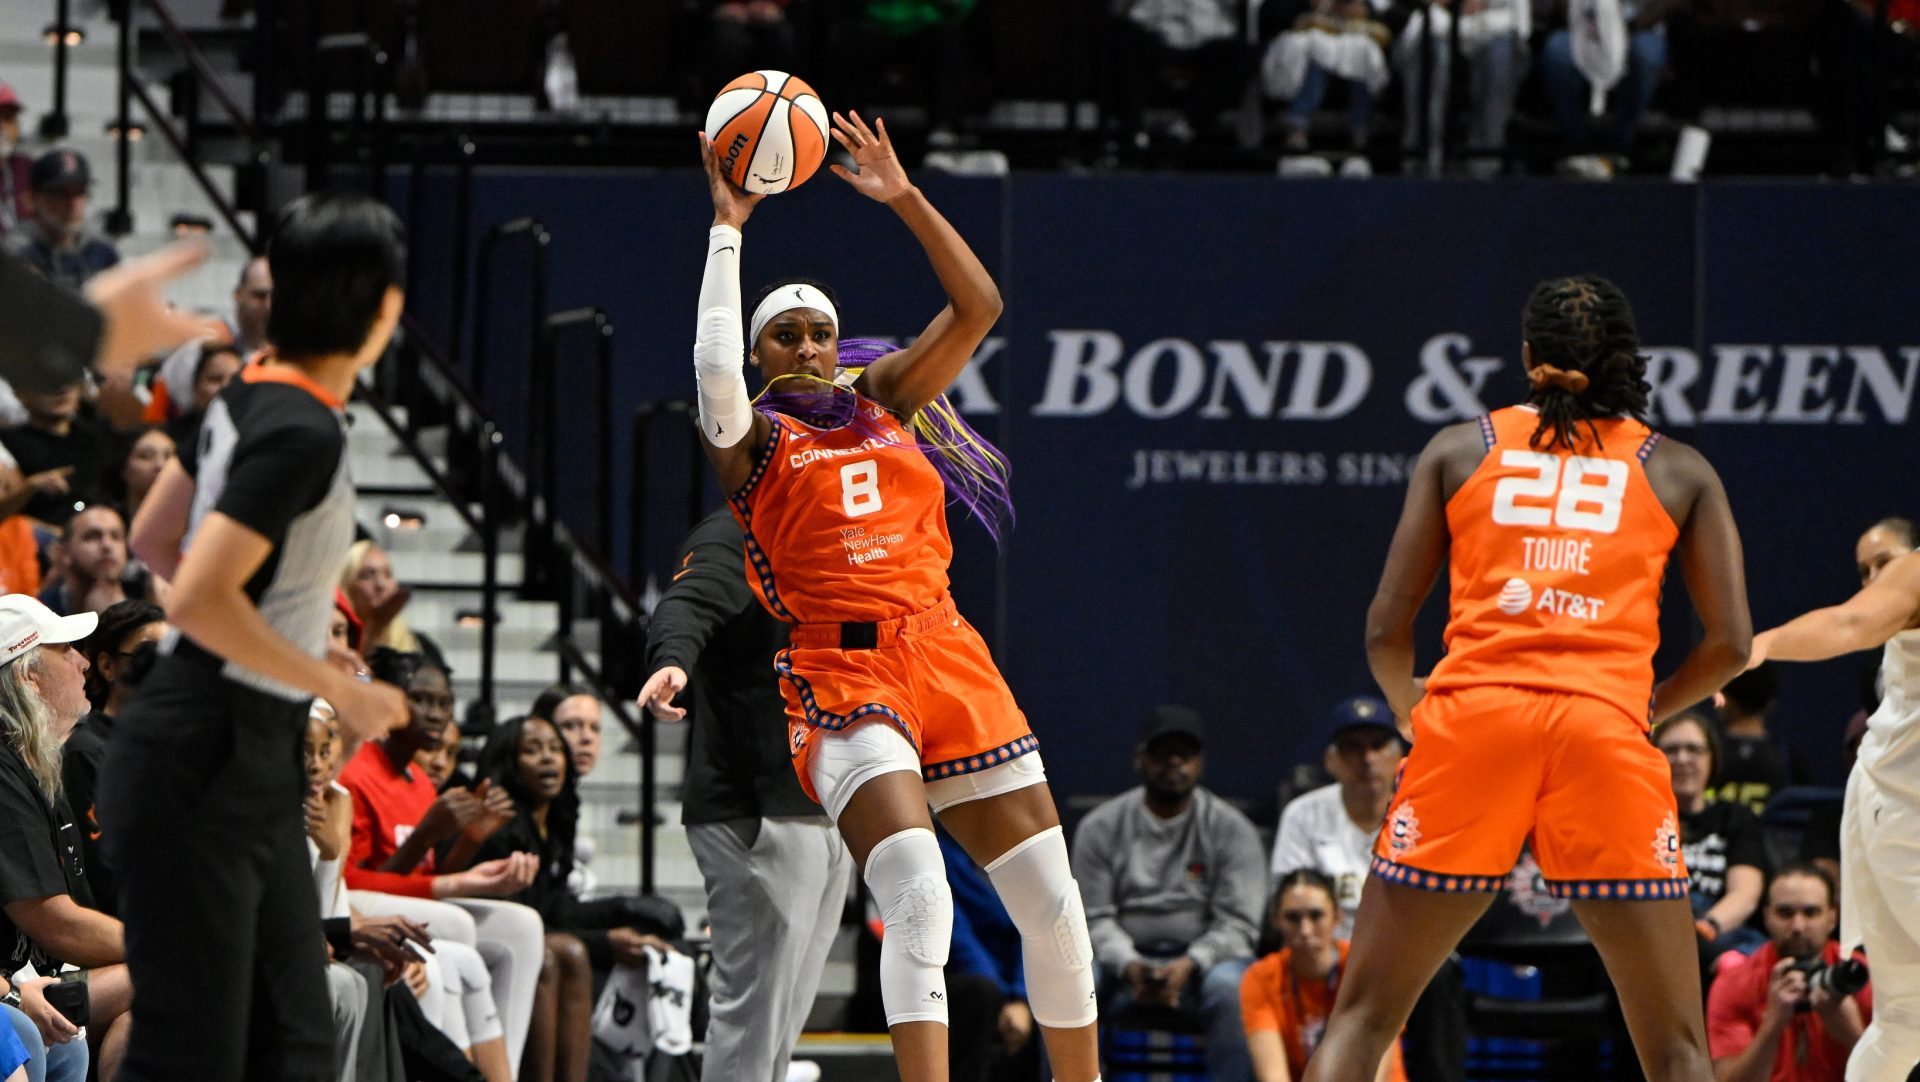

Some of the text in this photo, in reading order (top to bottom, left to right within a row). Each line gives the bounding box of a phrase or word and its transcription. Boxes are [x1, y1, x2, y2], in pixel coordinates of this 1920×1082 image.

[1031, 329, 1373, 420] BOND
[1404, 332, 1503, 423] &
[1639, 344, 1920, 428] REEN
[789, 430, 900, 469] CONNECT
[1126, 449, 1418, 489] JEWELERS SIN
[840, 458, 883, 518] 8
[1491, 449, 1629, 534] 28
[840, 526, 865, 540] Yale
[843, 533, 904, 552] NewHaven
[847, 547, 889, 566] Health
[1521, 536, 1593, 575] TOURÉ
[1535, 587, 1605, 620] AT&T
